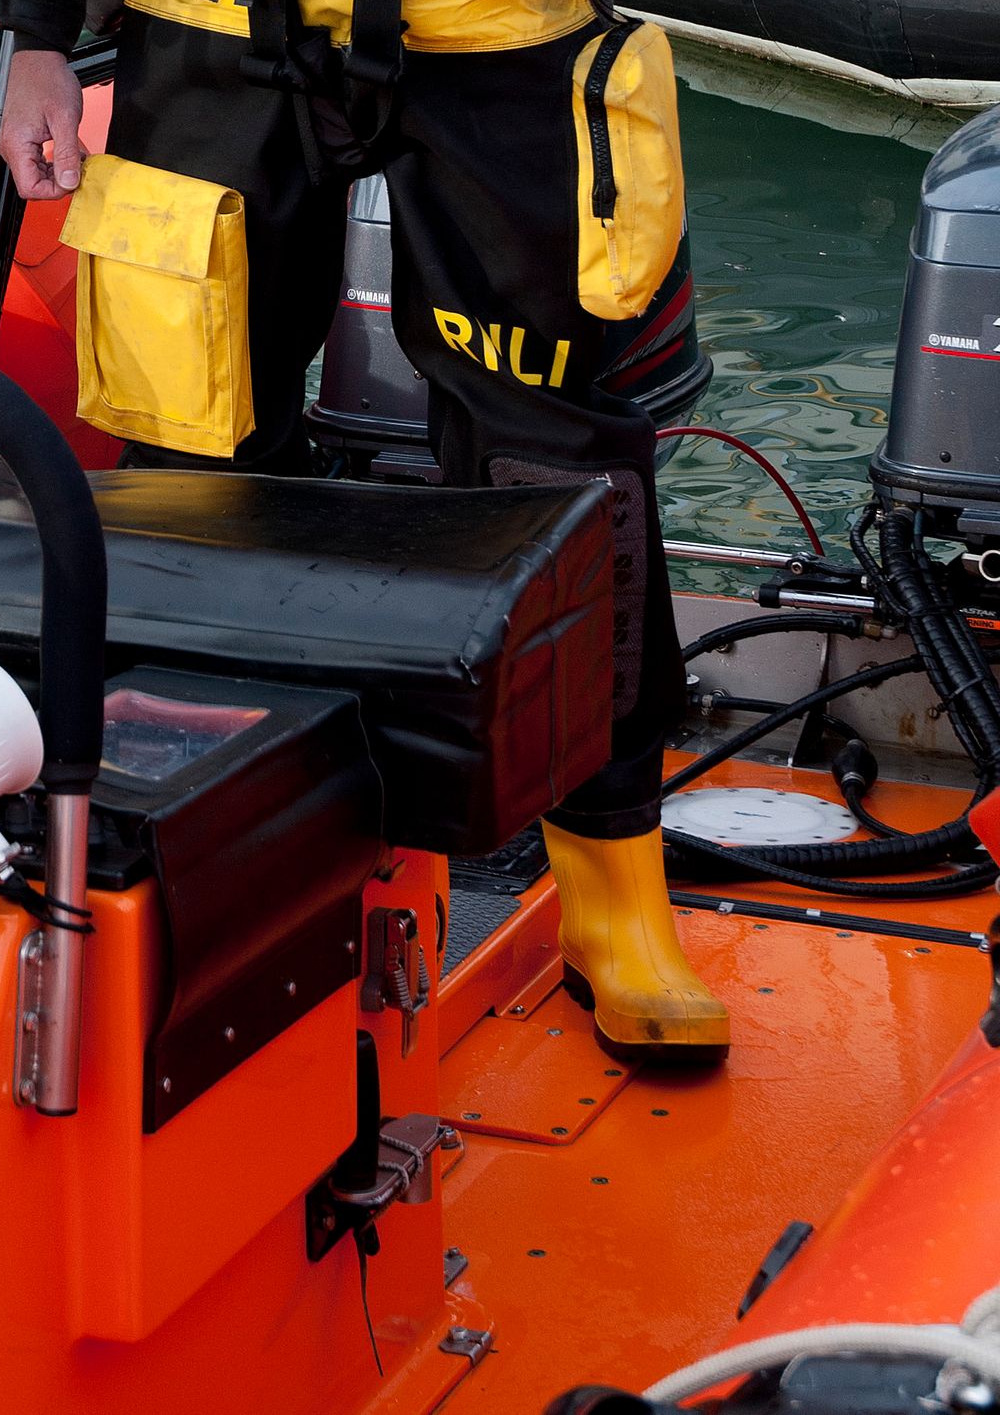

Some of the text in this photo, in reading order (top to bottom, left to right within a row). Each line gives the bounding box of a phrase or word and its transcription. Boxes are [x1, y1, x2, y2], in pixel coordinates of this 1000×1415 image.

[356, 290, 390, 304] YAMAHA
[433, 307, 571, 388] RNLI
[940, 335, 980, 351] YAMAHA
[968, 619, 994, 629] RNING
